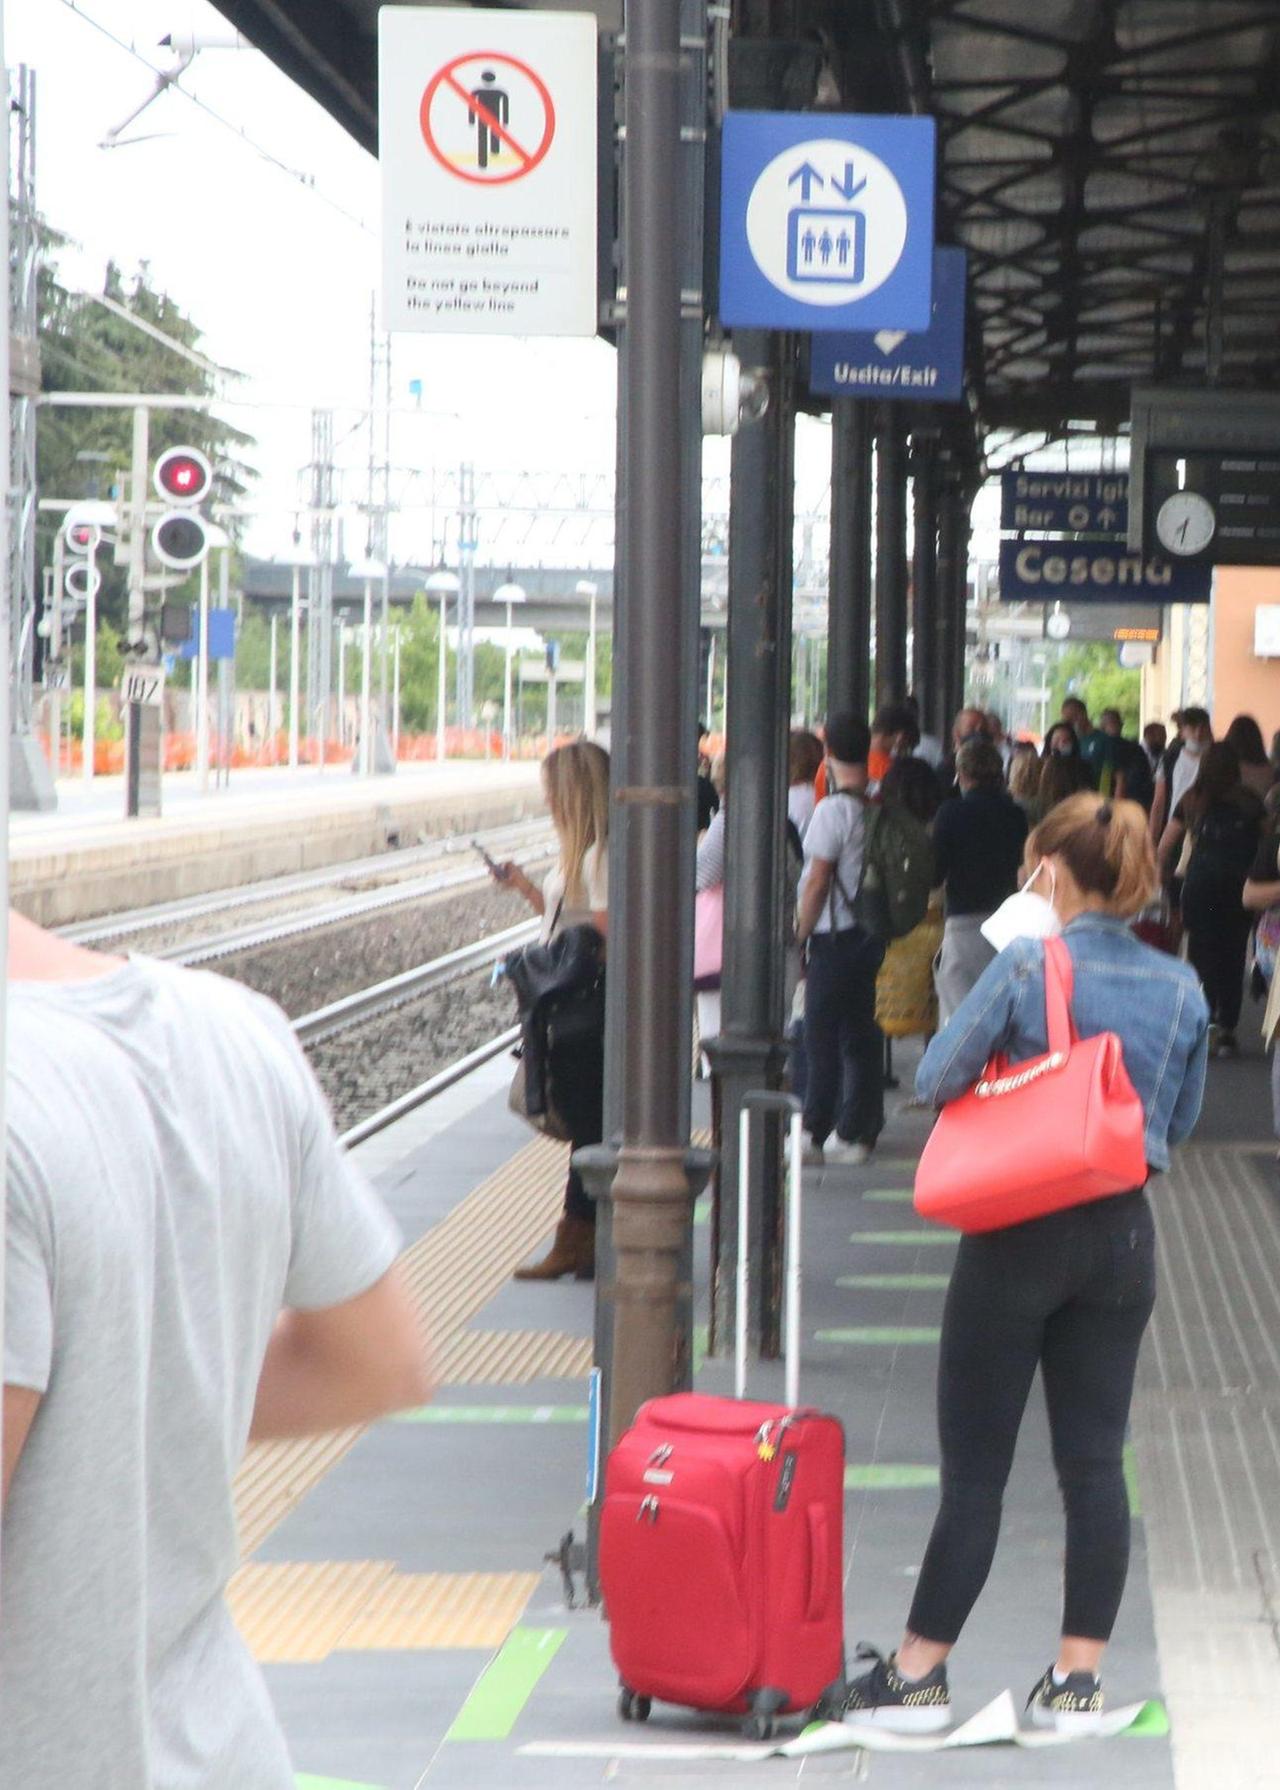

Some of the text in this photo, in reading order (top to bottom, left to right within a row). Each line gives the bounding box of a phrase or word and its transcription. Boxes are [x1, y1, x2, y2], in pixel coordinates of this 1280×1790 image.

[424, 240, 462, 253] linea
[466, 241, 509, 257] gialla
[406, 278, 539, 295] Do not go beyond
[406, 296, 516, 313] the yellow line
[833, 362, 938, 387] Uscita/Exit
[1175, 458, 1187, 491] 1
[1015, 476, 1090, 498] Servizi
[1015, 504, 1055, 527] Bar
[1016, 545, 1173, 586] Cesena
